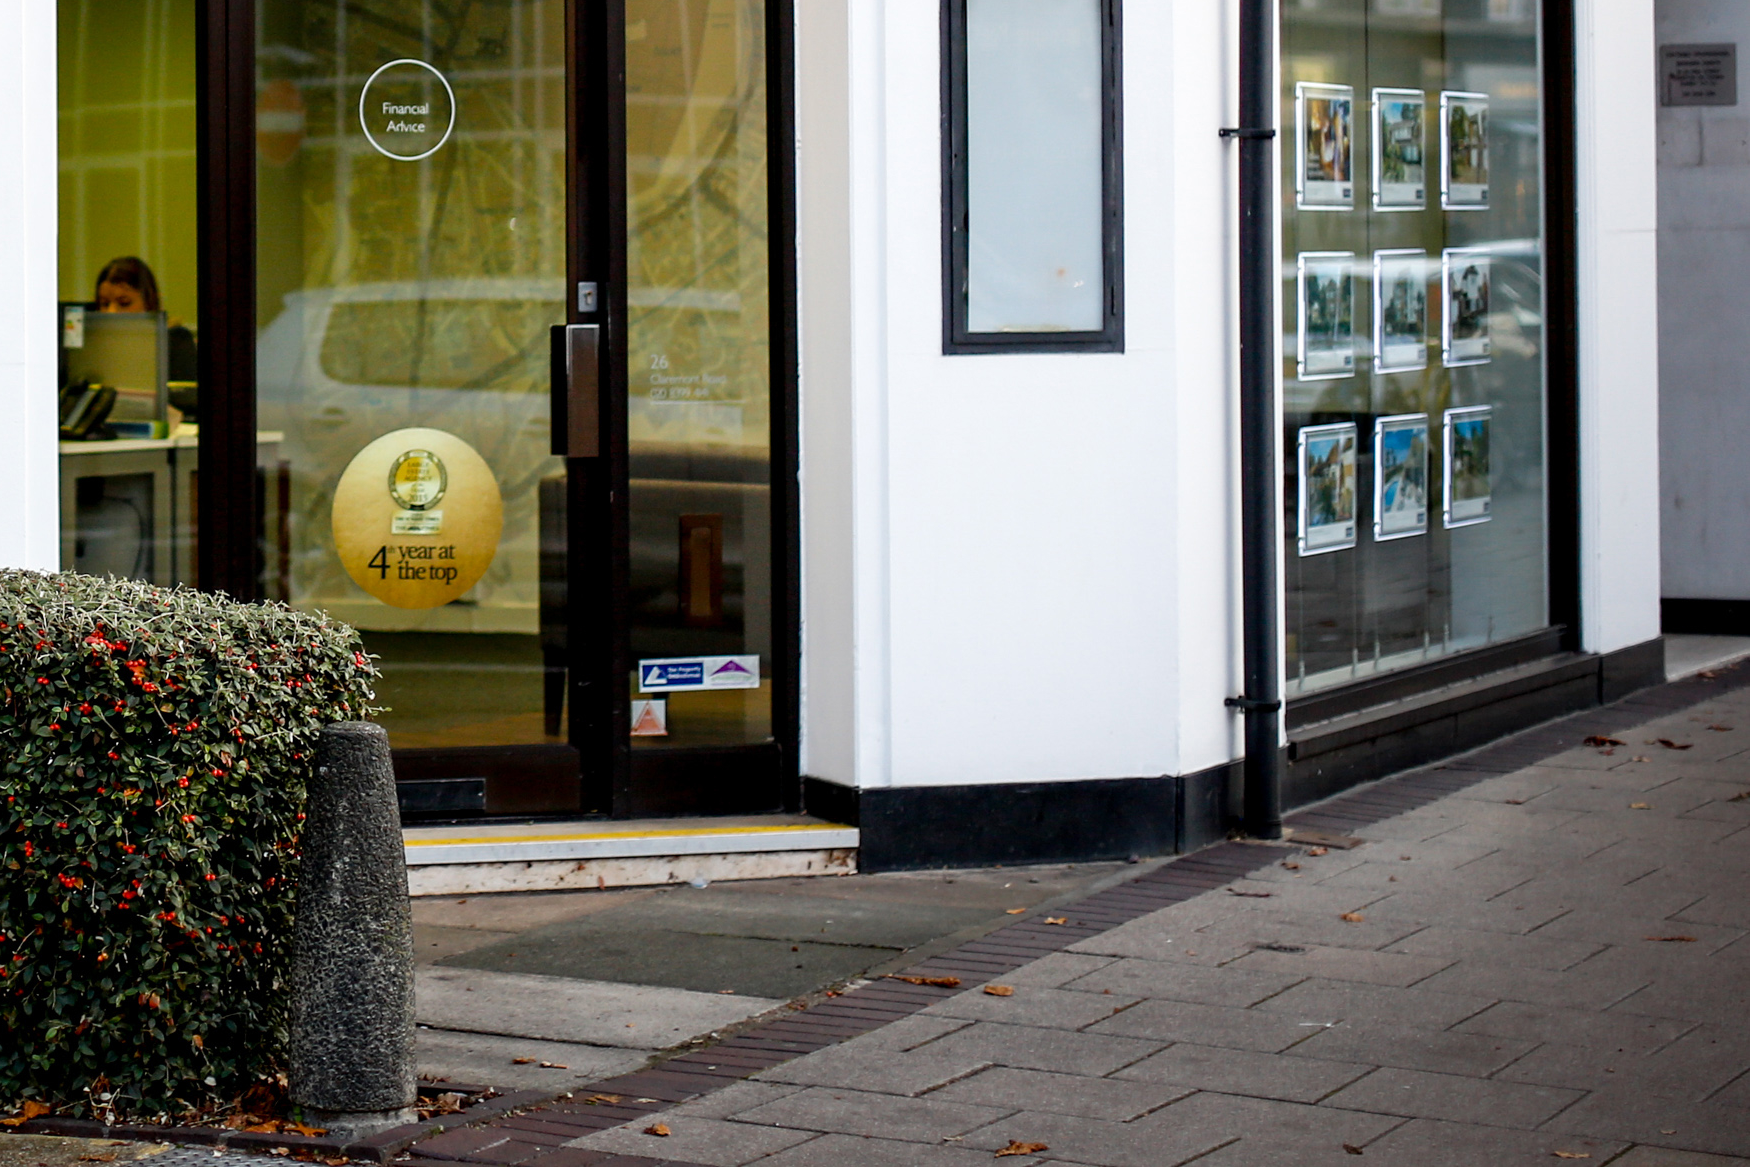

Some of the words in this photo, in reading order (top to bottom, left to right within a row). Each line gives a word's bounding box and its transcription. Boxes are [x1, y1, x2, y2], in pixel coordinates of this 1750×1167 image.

[382, 102, 429, 114] Financial
[386, 120, 425, 132] Advice
[650, 354, 669, 370] 26
[397, 546, 436, 564] year
[438, 545, 456, 560] at
[397, 562, 427, 580] the
[429, 564, 458, 584] top
